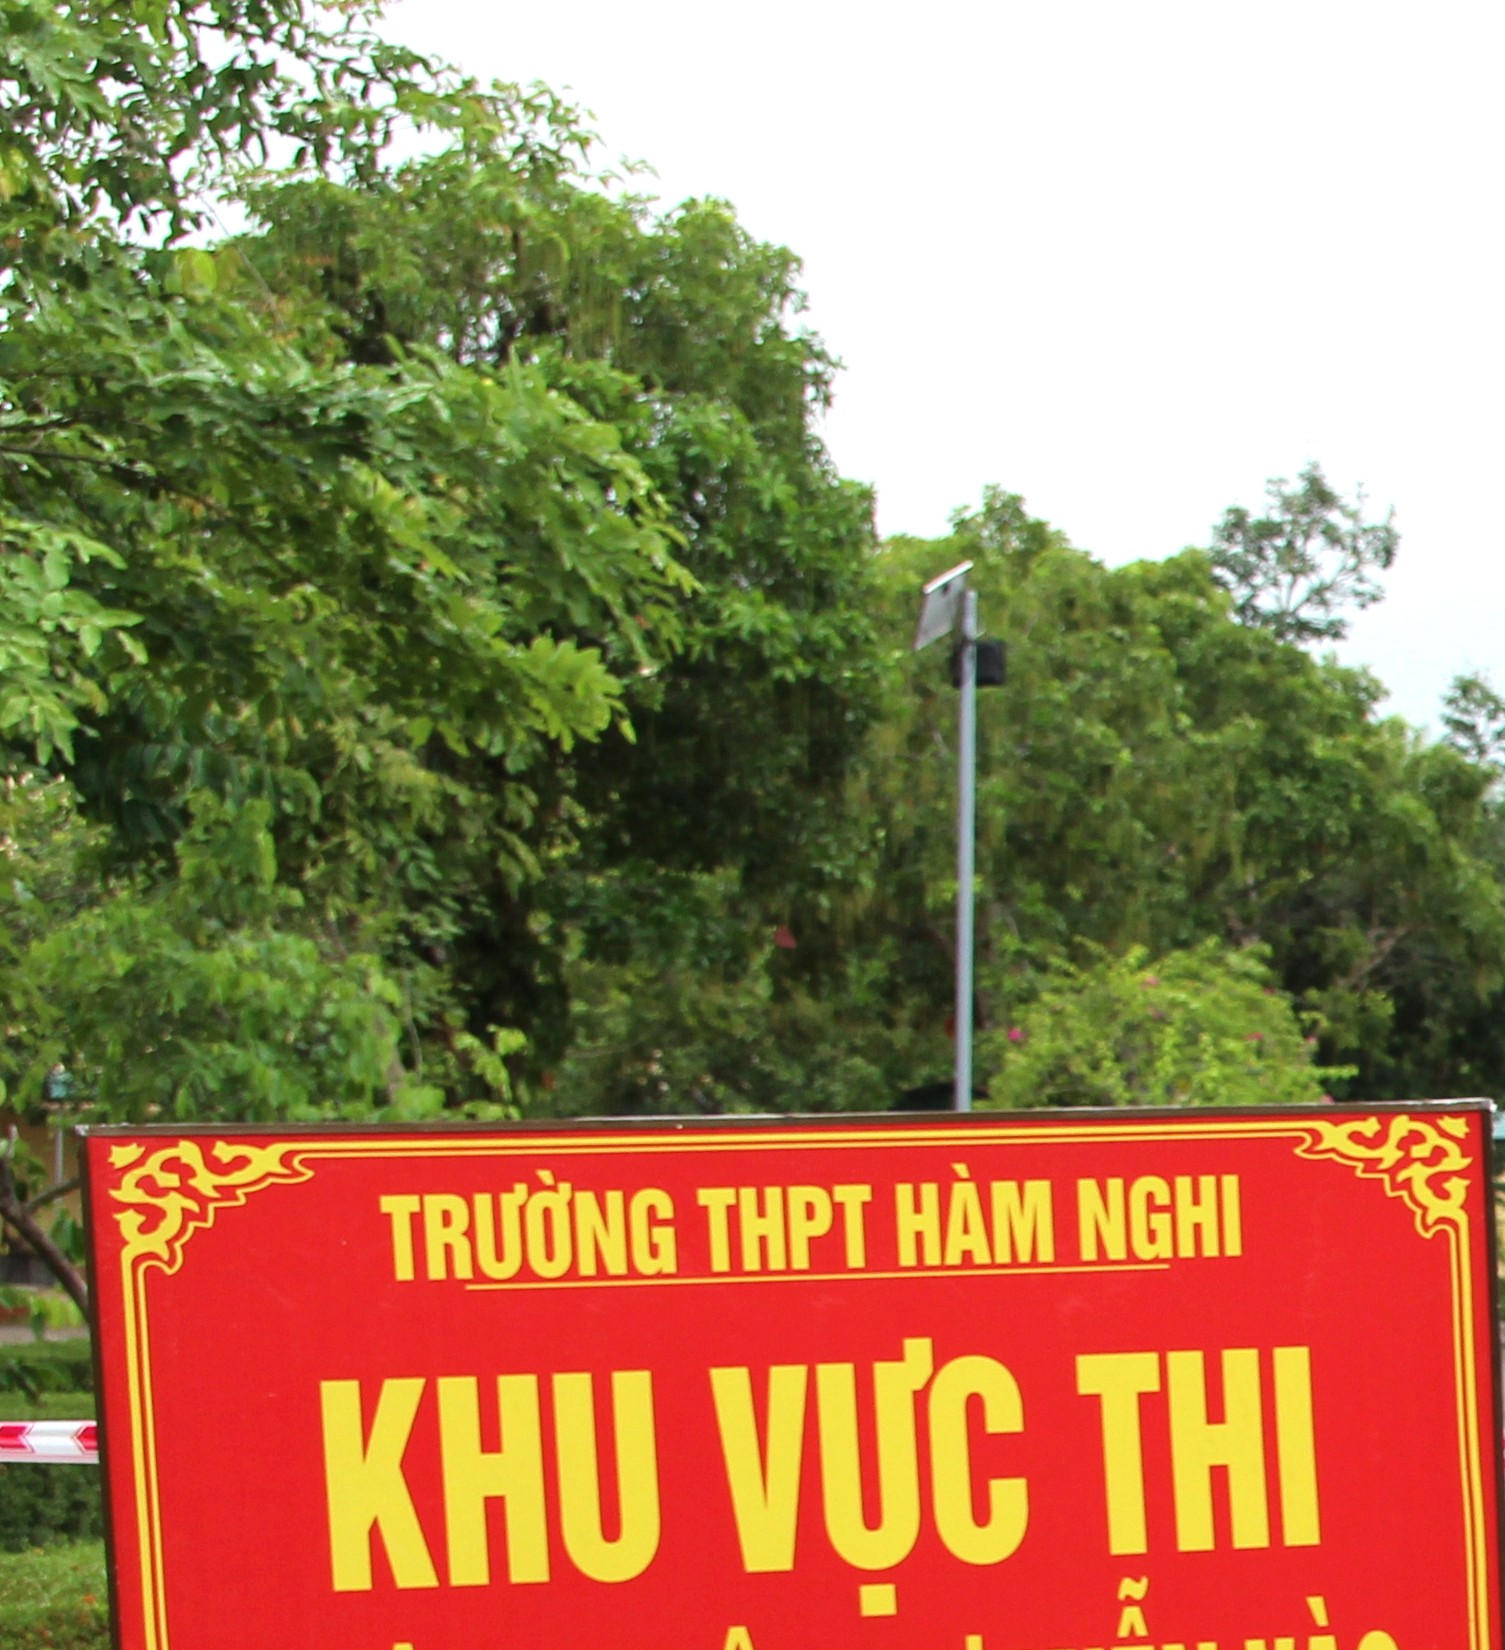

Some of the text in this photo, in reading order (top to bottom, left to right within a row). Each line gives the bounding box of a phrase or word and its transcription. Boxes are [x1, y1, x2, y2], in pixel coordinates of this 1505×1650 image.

[380, 1163, 1242, 1281] TRƯỜNG THPT HÀM NGHI
[321, 1337, 1321, 1617] KHU VỰC THI
